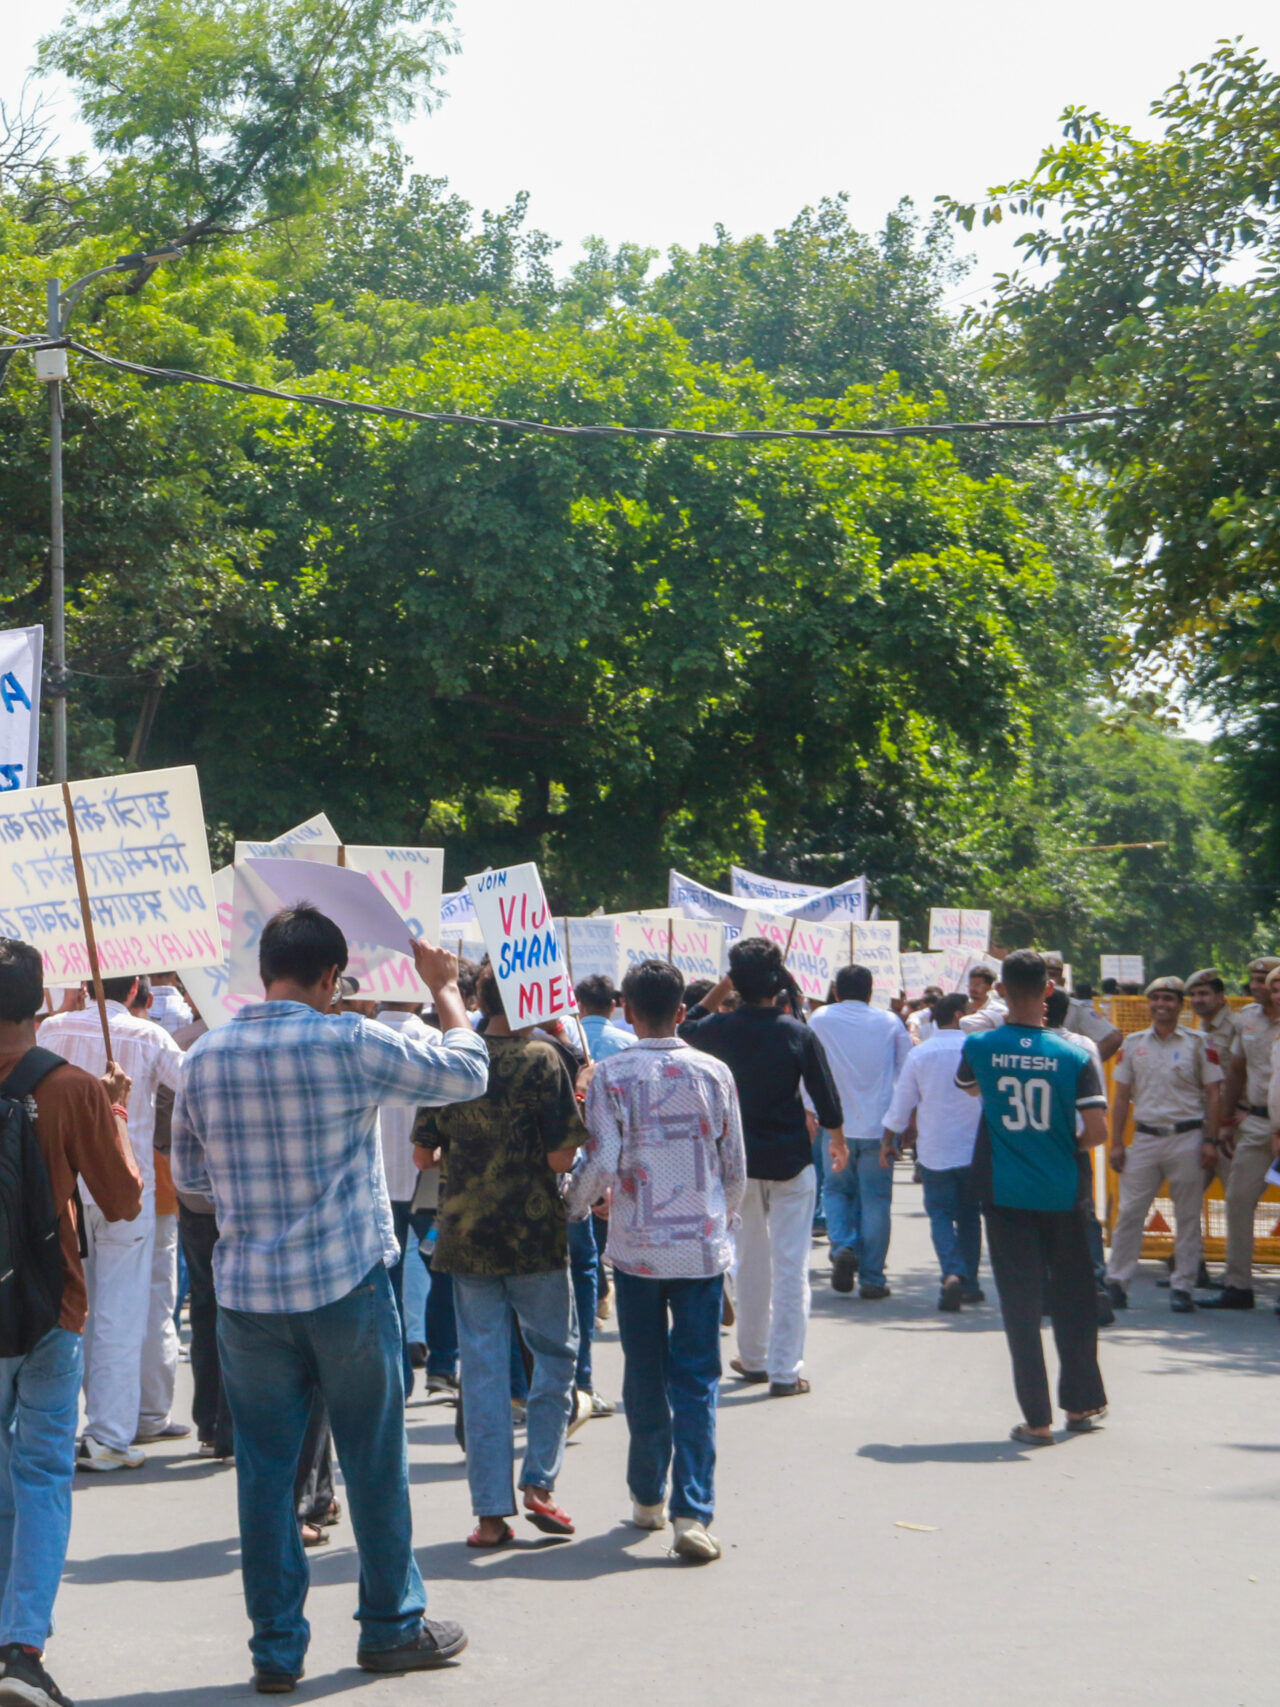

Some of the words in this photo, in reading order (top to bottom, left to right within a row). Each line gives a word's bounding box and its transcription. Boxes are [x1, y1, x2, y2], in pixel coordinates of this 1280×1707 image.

[478, 871, 507, 892] JOIN
[991, 1053, 1058, 1071] HITESH
[996, 1075, 1052, 1132] 30
